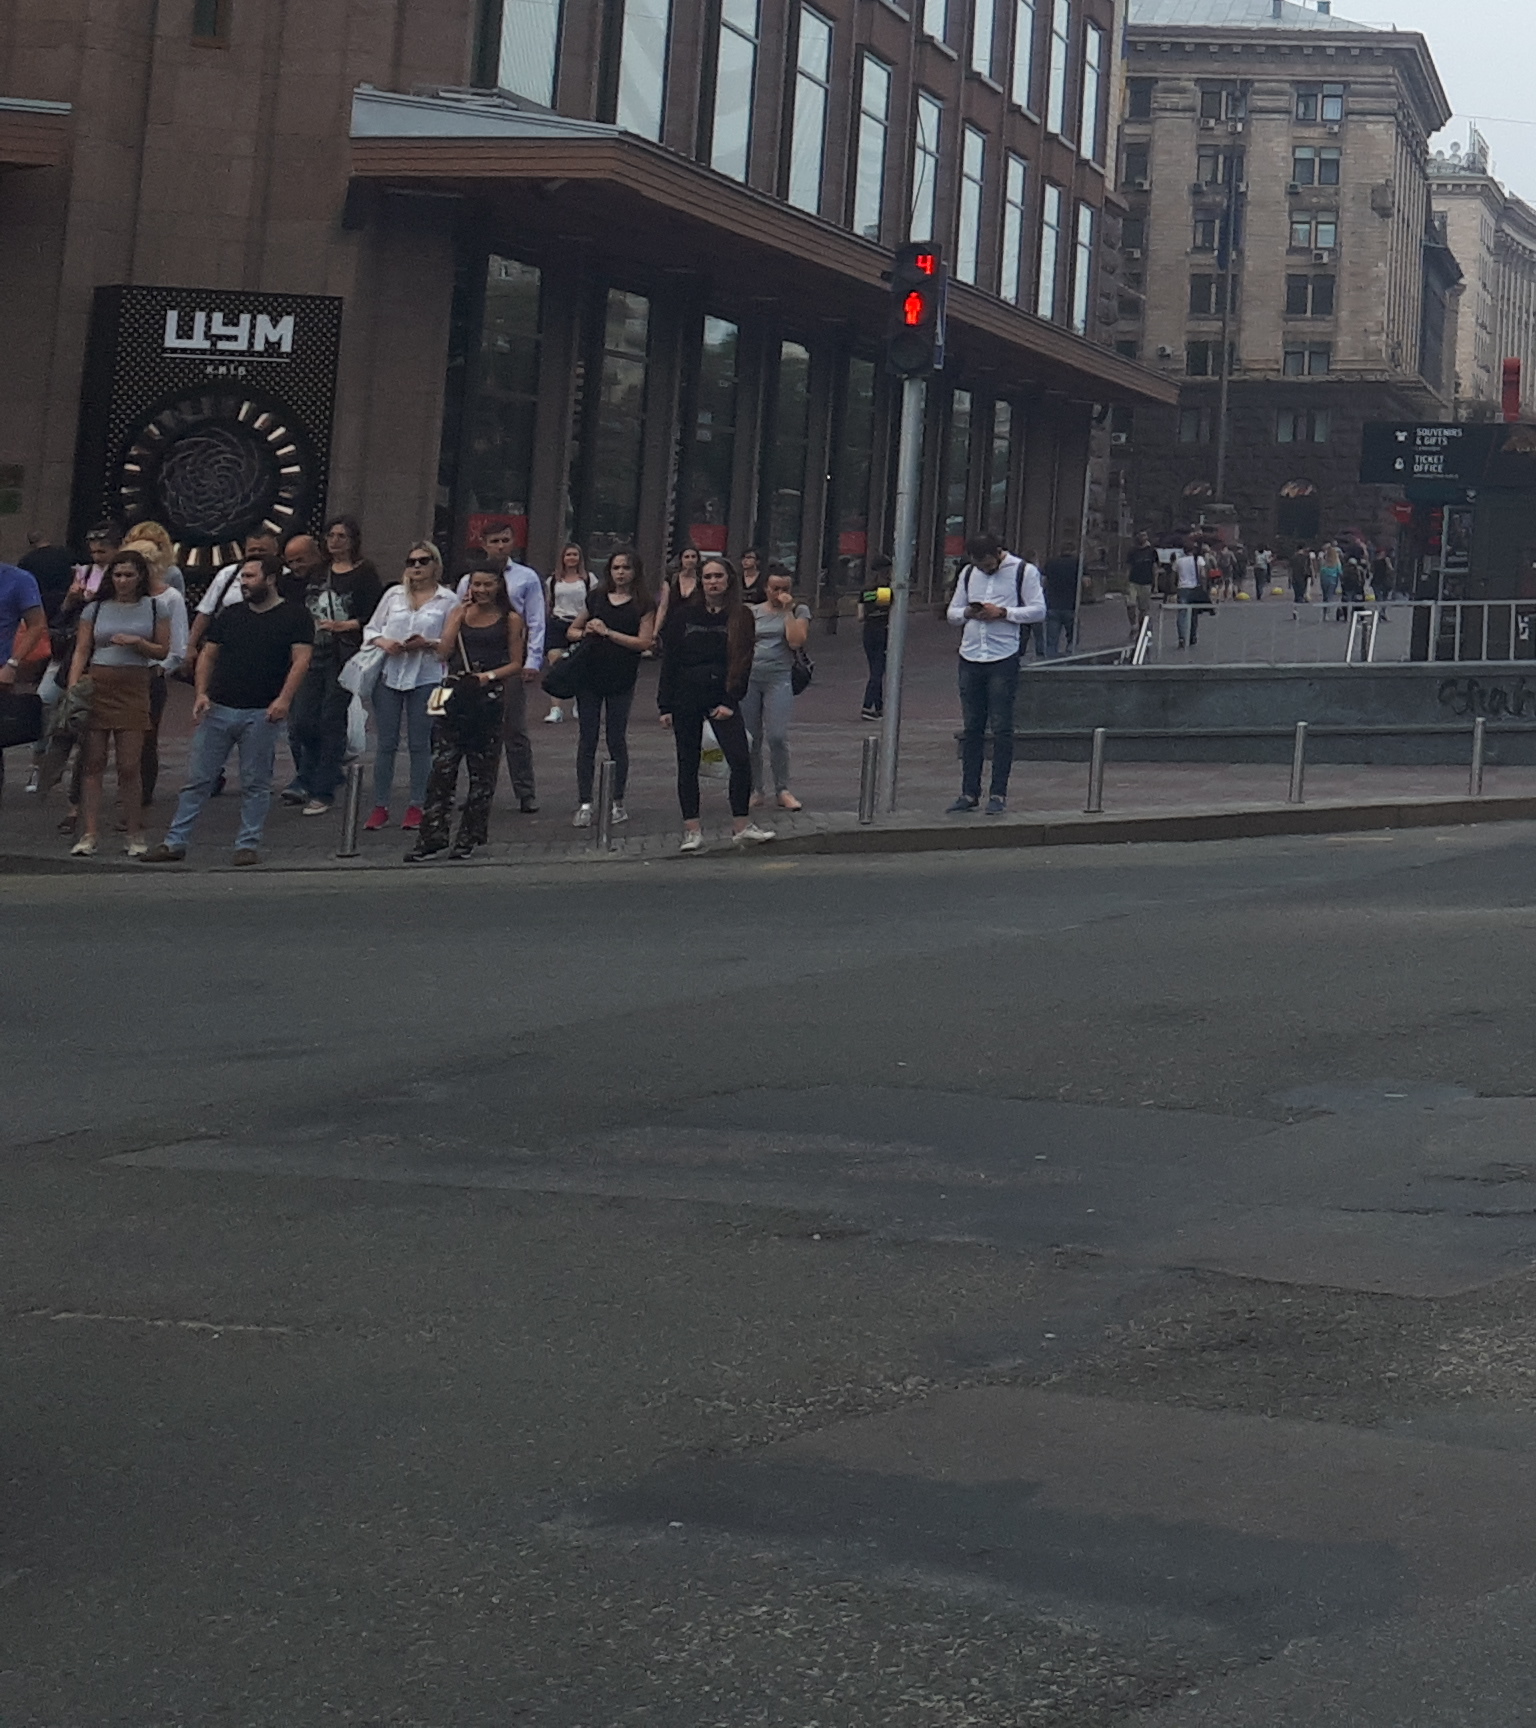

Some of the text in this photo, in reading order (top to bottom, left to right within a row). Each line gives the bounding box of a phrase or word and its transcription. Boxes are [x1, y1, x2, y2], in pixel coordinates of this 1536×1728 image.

[915, 255, 934, 275] 4
[164, 309, 295, 353] ЦУМ
[1416, 428, 1463, 437] SOUVENIRS
[1424, 437, 1448, 445] GIFTS
[1414, 455, 1444, 463] TICKET
[1413, 464, 1443, 473] OFFICE
